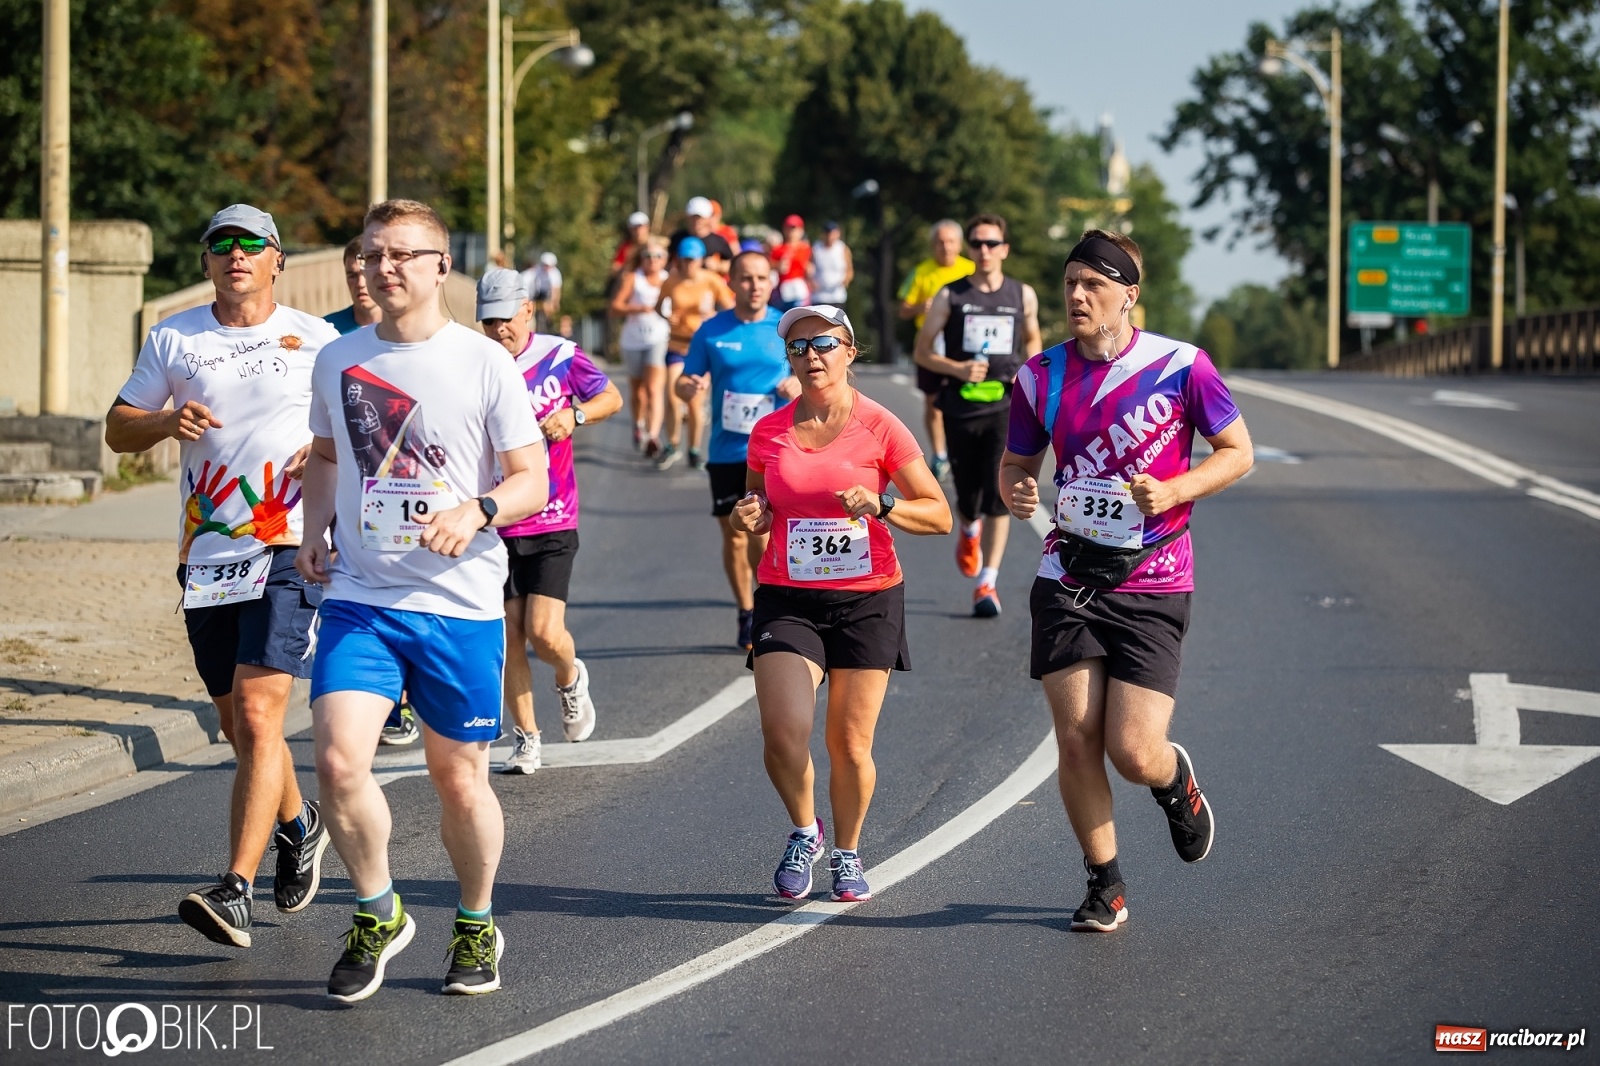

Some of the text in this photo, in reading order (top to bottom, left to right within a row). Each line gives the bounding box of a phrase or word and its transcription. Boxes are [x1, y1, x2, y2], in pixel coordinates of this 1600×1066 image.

[529, 374, 561, 412] KO
[1083, 496, 1124, 520] 332
[812, 535, 851, 555] 362
[213, 559, 252, 582] 338
